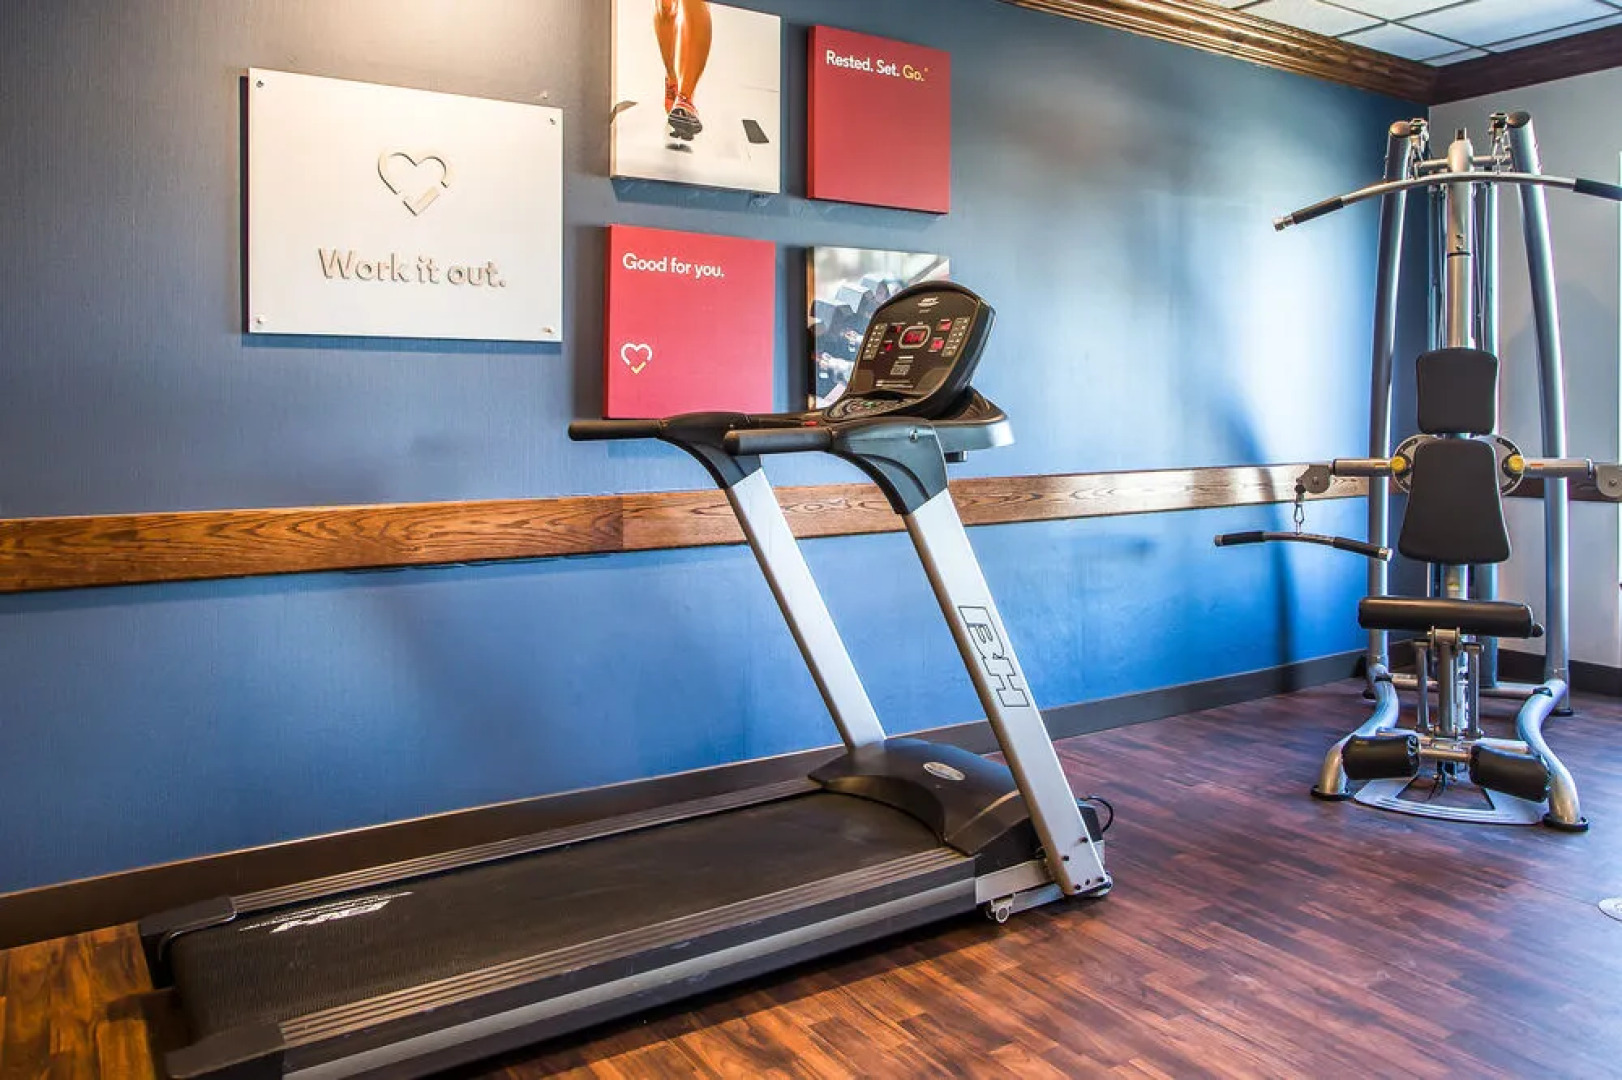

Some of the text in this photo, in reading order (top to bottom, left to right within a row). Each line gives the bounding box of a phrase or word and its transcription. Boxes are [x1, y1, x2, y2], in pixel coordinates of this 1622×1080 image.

[826, 49, 874, 72] Rested.
[875, 59, 901, 77] Set.
[317, 247, 507, 288] Work it out.
[622, 252, 726, 280] Good for you.
